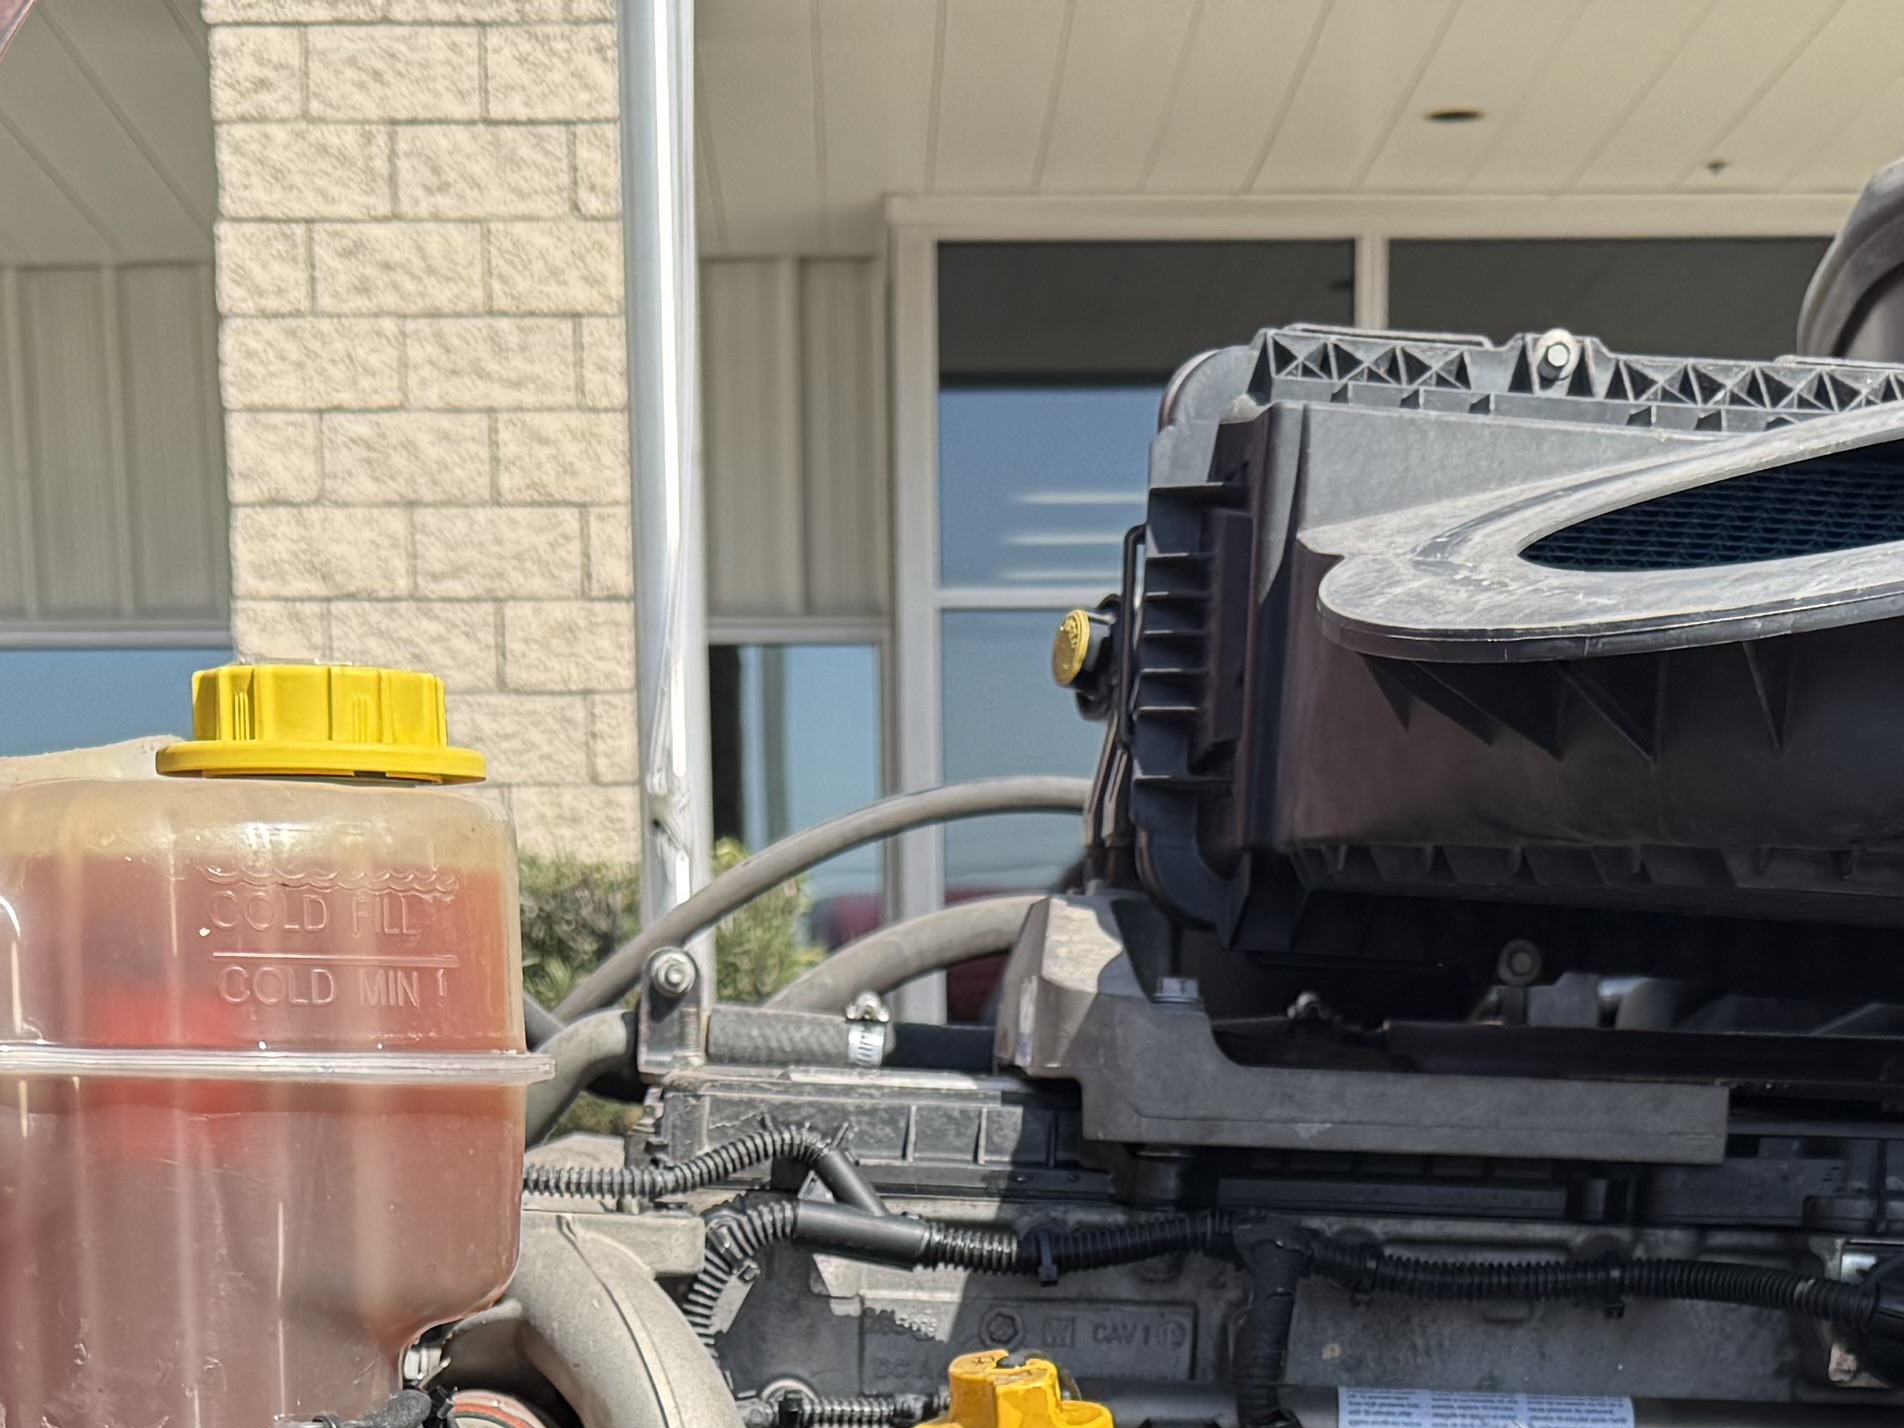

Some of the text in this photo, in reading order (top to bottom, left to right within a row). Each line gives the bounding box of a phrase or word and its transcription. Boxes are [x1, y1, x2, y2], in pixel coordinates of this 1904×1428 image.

[209, 890, 421, 937] COLD FILL
[217, 966, 420, 1008] COLD MIN
